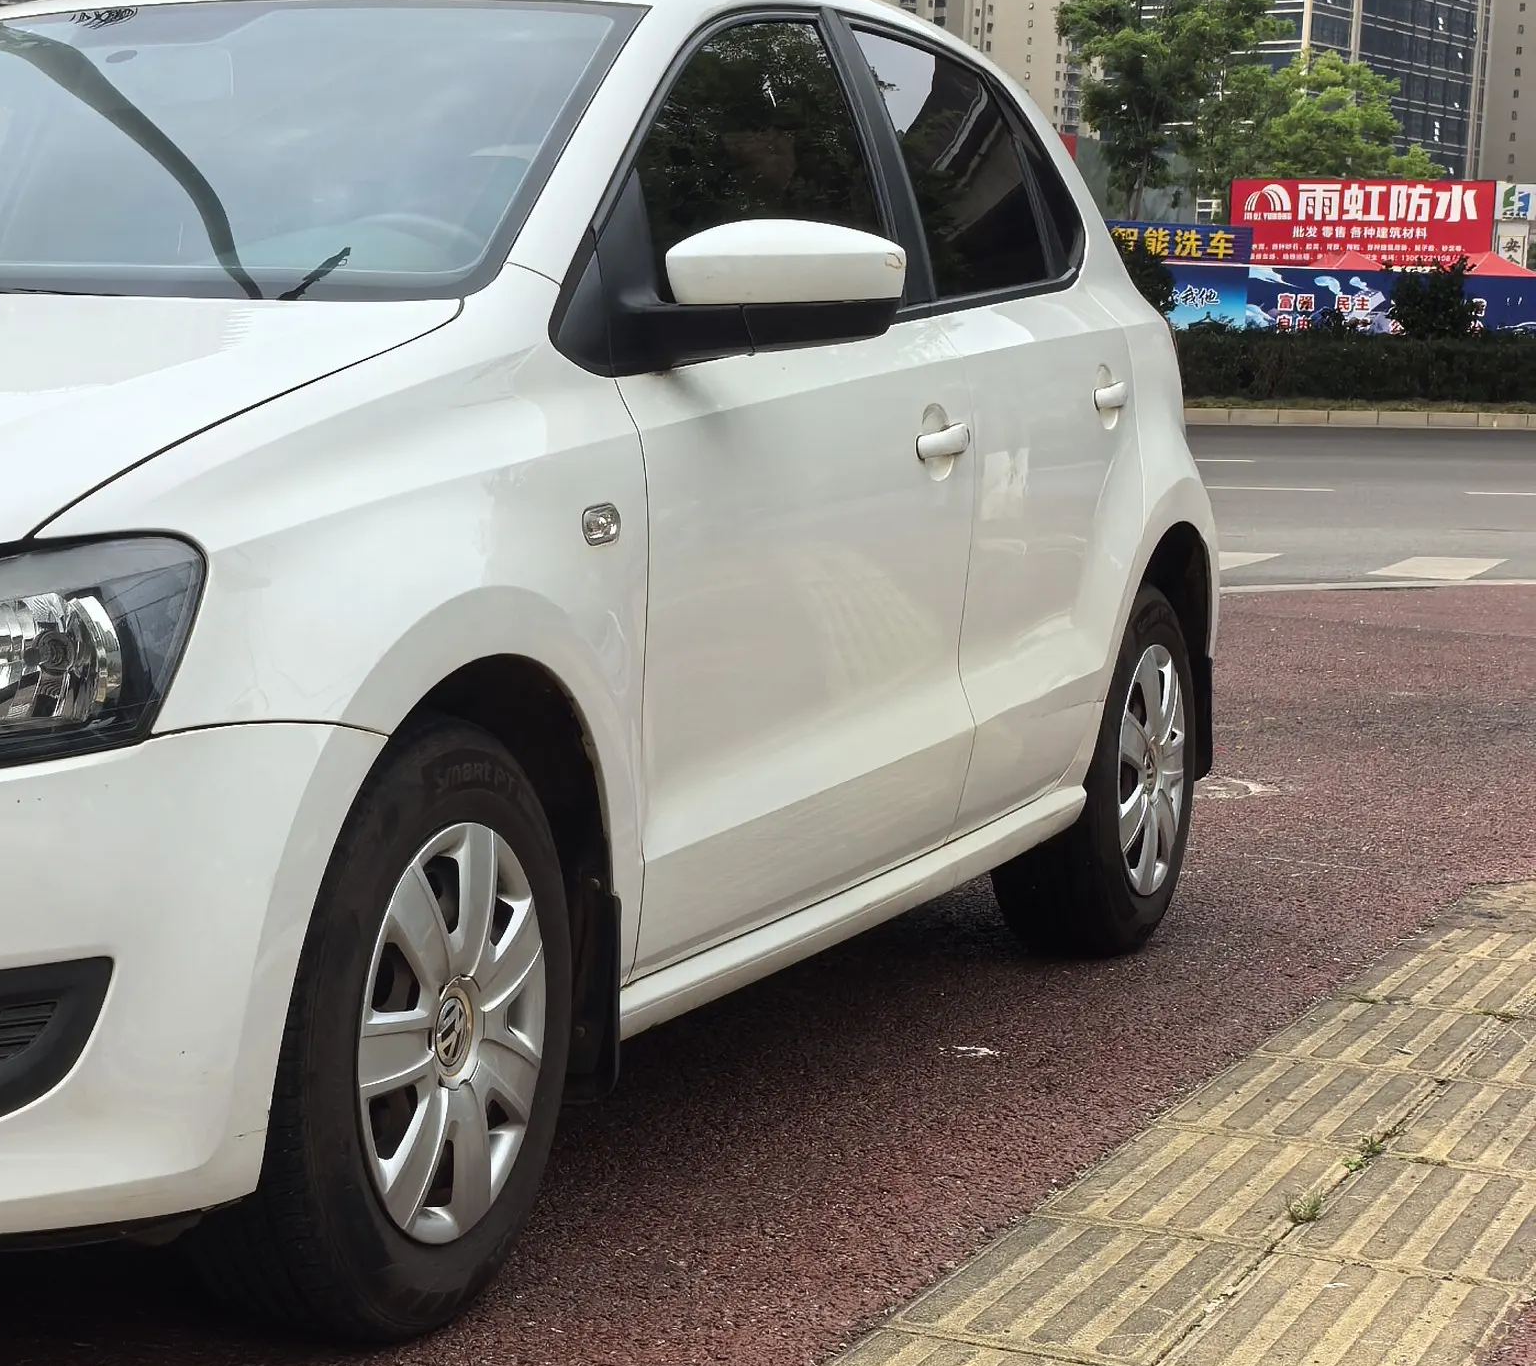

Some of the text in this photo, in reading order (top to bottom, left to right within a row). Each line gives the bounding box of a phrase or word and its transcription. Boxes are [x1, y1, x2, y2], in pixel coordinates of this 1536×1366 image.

[1297, 183, 1478, 222] 雨虹防水
[1292, 225, 1428, 239] 批发 零售 各种建筑材料
[1278, 293, 1370, 312] 富强 民主
